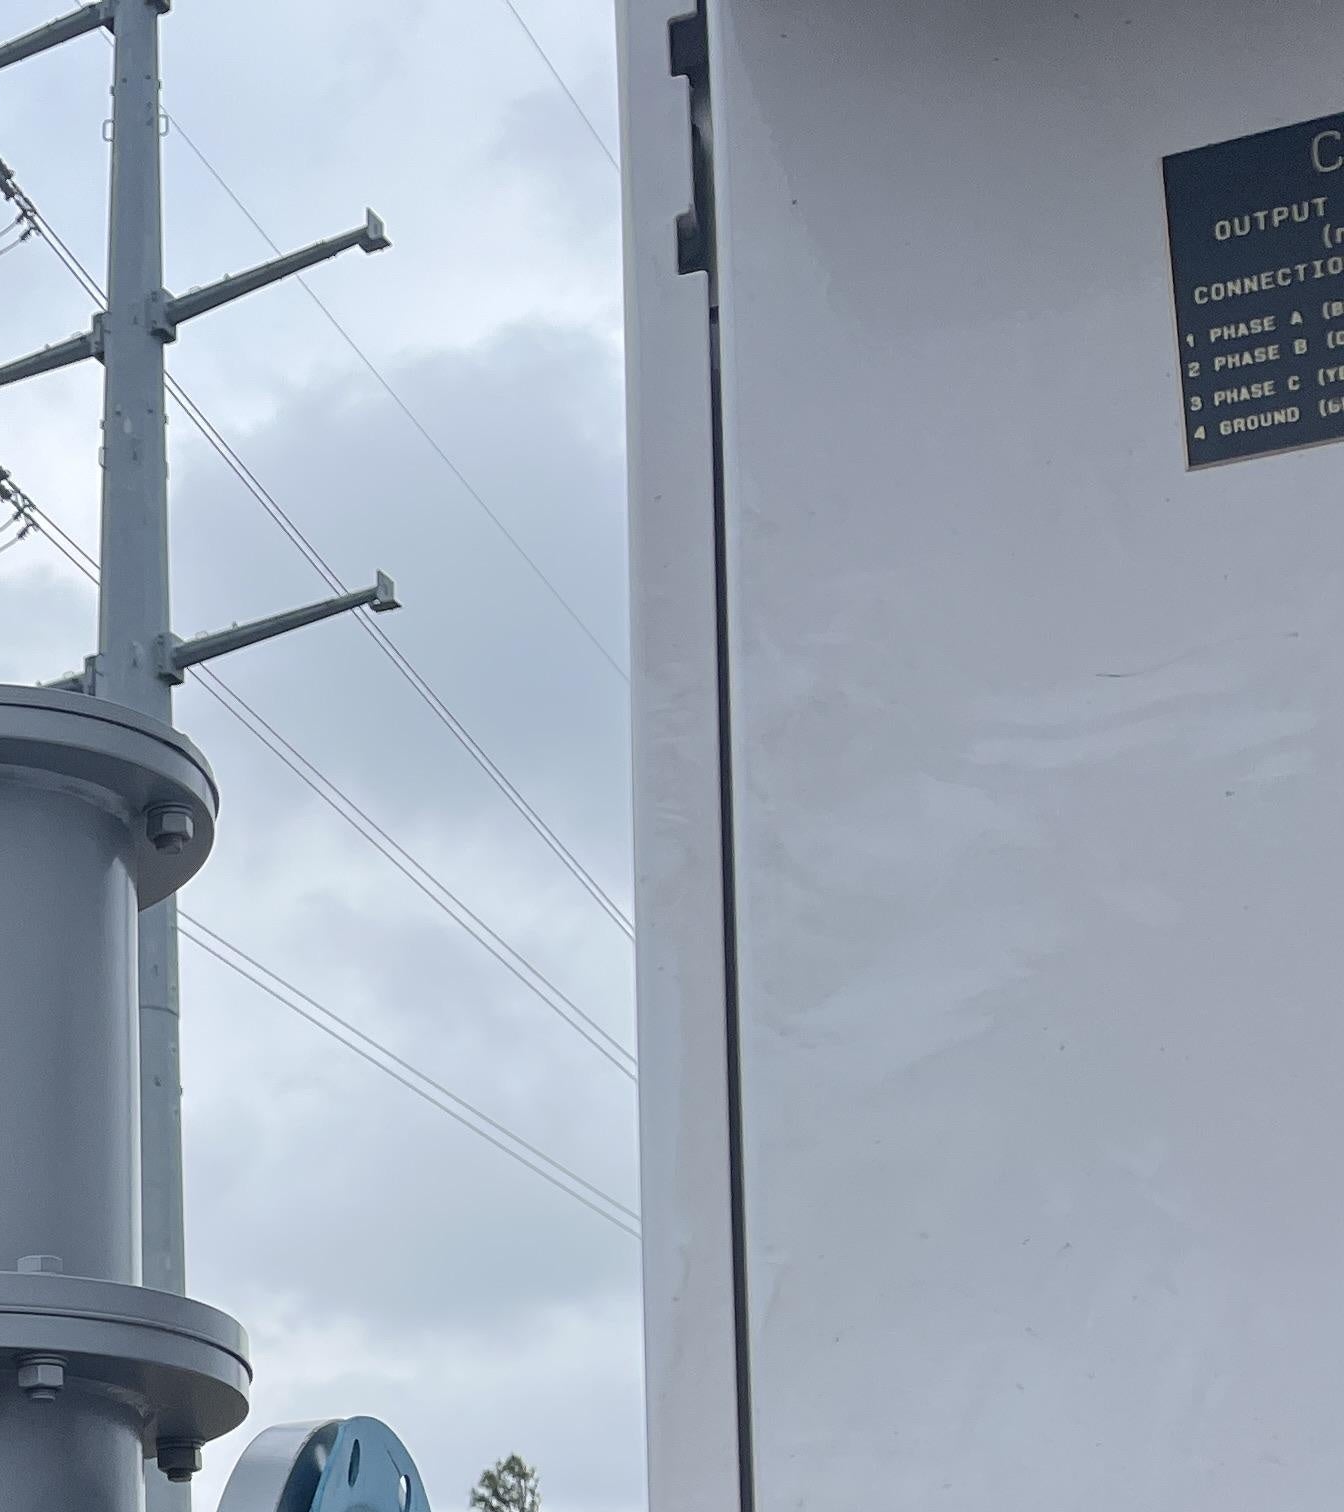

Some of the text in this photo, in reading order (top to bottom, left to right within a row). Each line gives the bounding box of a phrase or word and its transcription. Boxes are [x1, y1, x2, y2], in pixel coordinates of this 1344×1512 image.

[1215, 197, 1328, 241] OUTPUT
[1194, 256, 1344, 304] CONNECTIO
[1187, 334, 1194, 347] 1
[1210, 316, 1277, 342] PHASE
[1291, 310, 1303, 325] A
[1189, 361, 1201, 378] 2
[1214, 344, 1280, 371] PHASE
[1294, 338, 1307, 354] B
[1191, 396, 1202, 411] 3
[1214, 380, 1278, 407] PHASE
[1287, 375, 1300, 391] C
[1194, 425, 1206, 440] 4
[1219, 406, 1300, 435] GROUND
